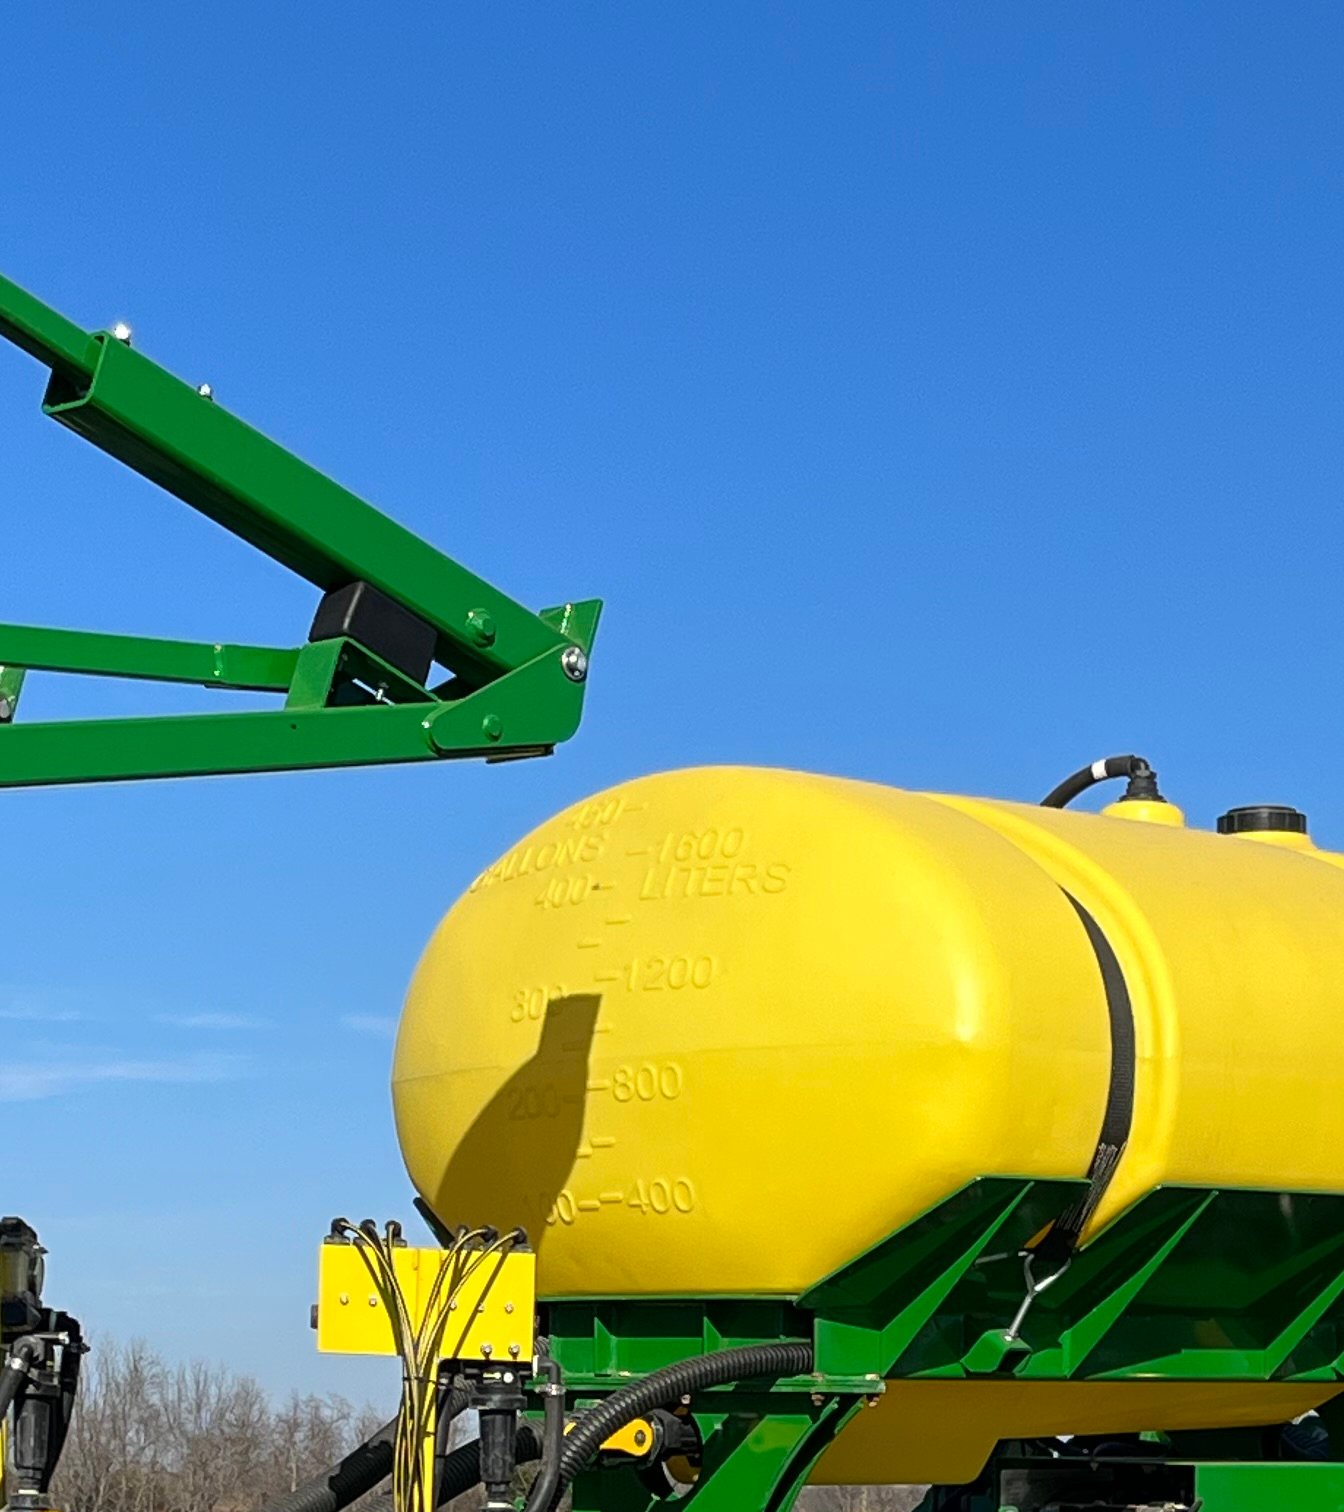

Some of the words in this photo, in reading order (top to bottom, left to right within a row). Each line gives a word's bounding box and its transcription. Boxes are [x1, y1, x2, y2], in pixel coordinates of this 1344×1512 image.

[656, 826, 746, 864] 1600
[534, 873, 593, 909] 400
[639, 862, 793, 901] LITERS
[623, 955, 718, 992] 1200
[612, 1060, 683, 1103] 800
[627, 1176, 696, 1215] 400
